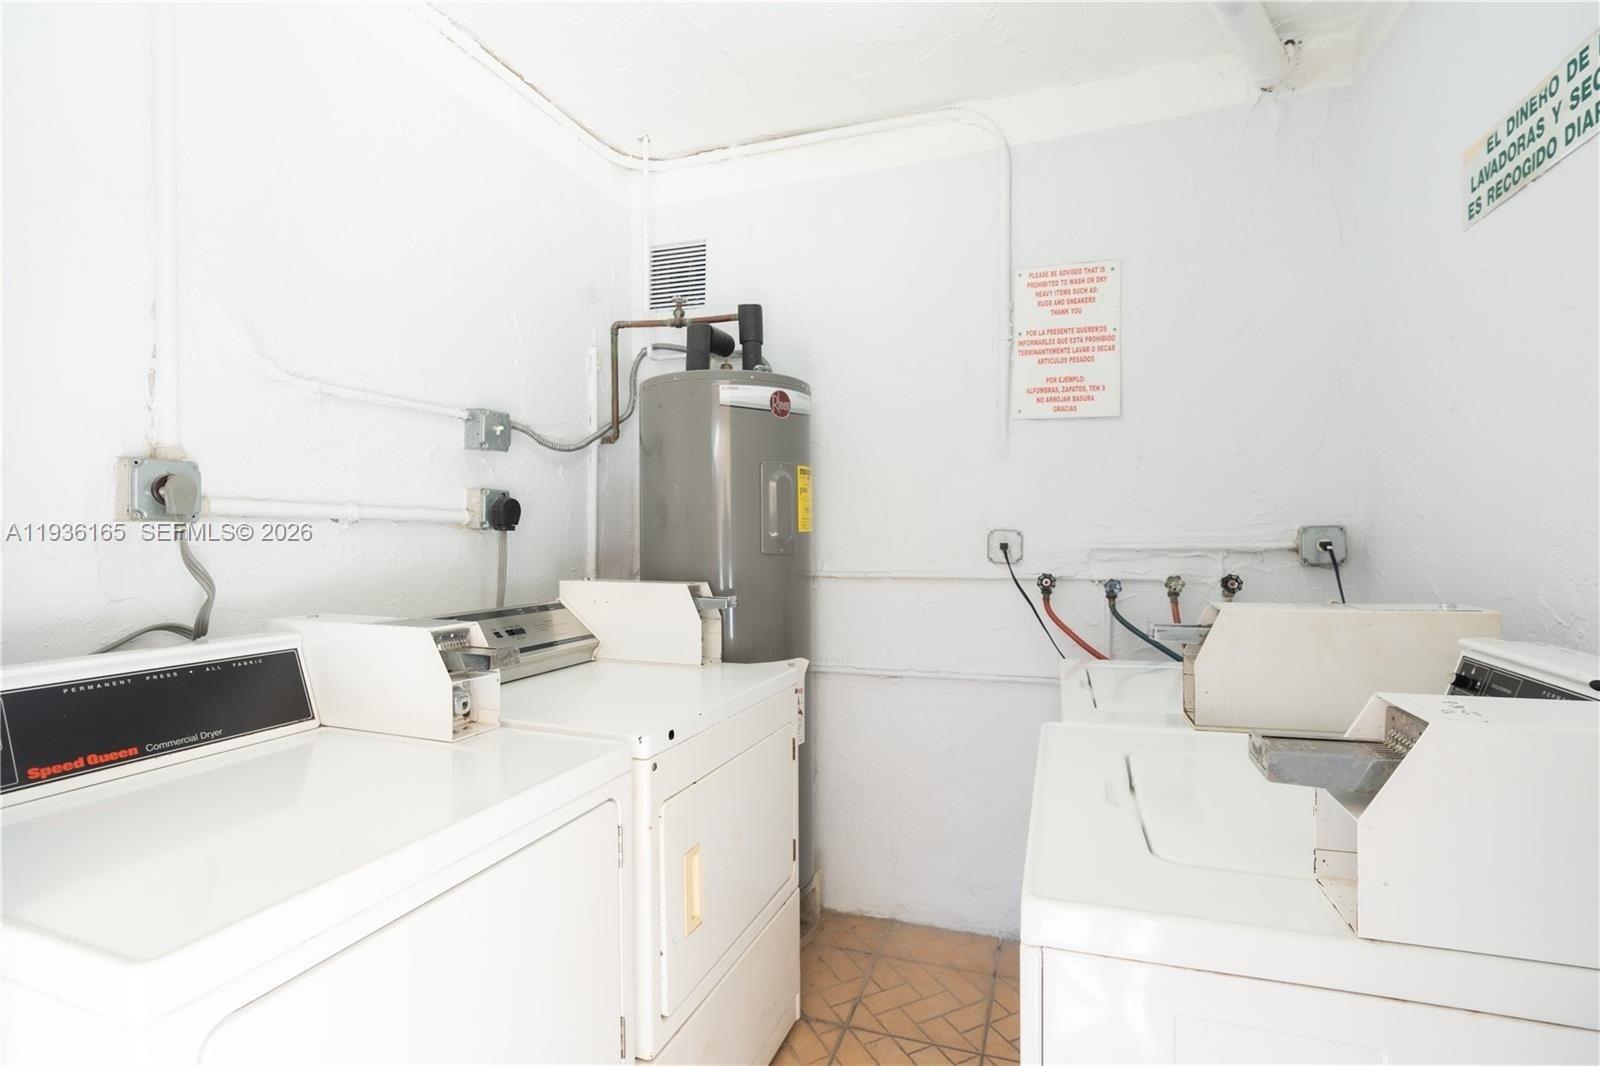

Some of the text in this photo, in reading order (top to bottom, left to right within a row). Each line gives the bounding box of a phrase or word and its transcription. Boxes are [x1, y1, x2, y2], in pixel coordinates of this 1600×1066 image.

[1487, 45, 1590, 154] EL DINERO DE
[1470, 116, 1545, 194] LAVADORAS
[1551, 100, 1563, 125] Y
[1467, 196, 1482, 221] ES
[1487, 136, 1558, 206] RECOGIDO
[1029, 271, 1048, 279] PLEASE
[1059, 268, 1082, 276] ADVISED
[1027, 280, 1059, 288] PROHIBITED
[1046, 327, 1075, 335] PRESENTE
[1076, 325, 1107, 334] QUEREMOS
[1056, 337, 1068, 345] QUE
[1070, 336, 1083, 344] ESTA
[1085, 335, 1116, 343] PROHIBIDO
[1018, 347, 1071, 357] TERMINANTEMENTE
[1072, 346, 1090, 354] LAVAR
[1097, 344, 1116, 352] SECAR
[1037, 357, 1068, 365] ARTICULOS
[1072, 394, 1094, 402] BASURA
[63, 678, 132, 693] PERMANENT
[146, 671, 178, 680] PRESS
[232, 659, 263, 667] FABRIC
[27, 729, 223, 779] Speed Queen Commercial Dryer
